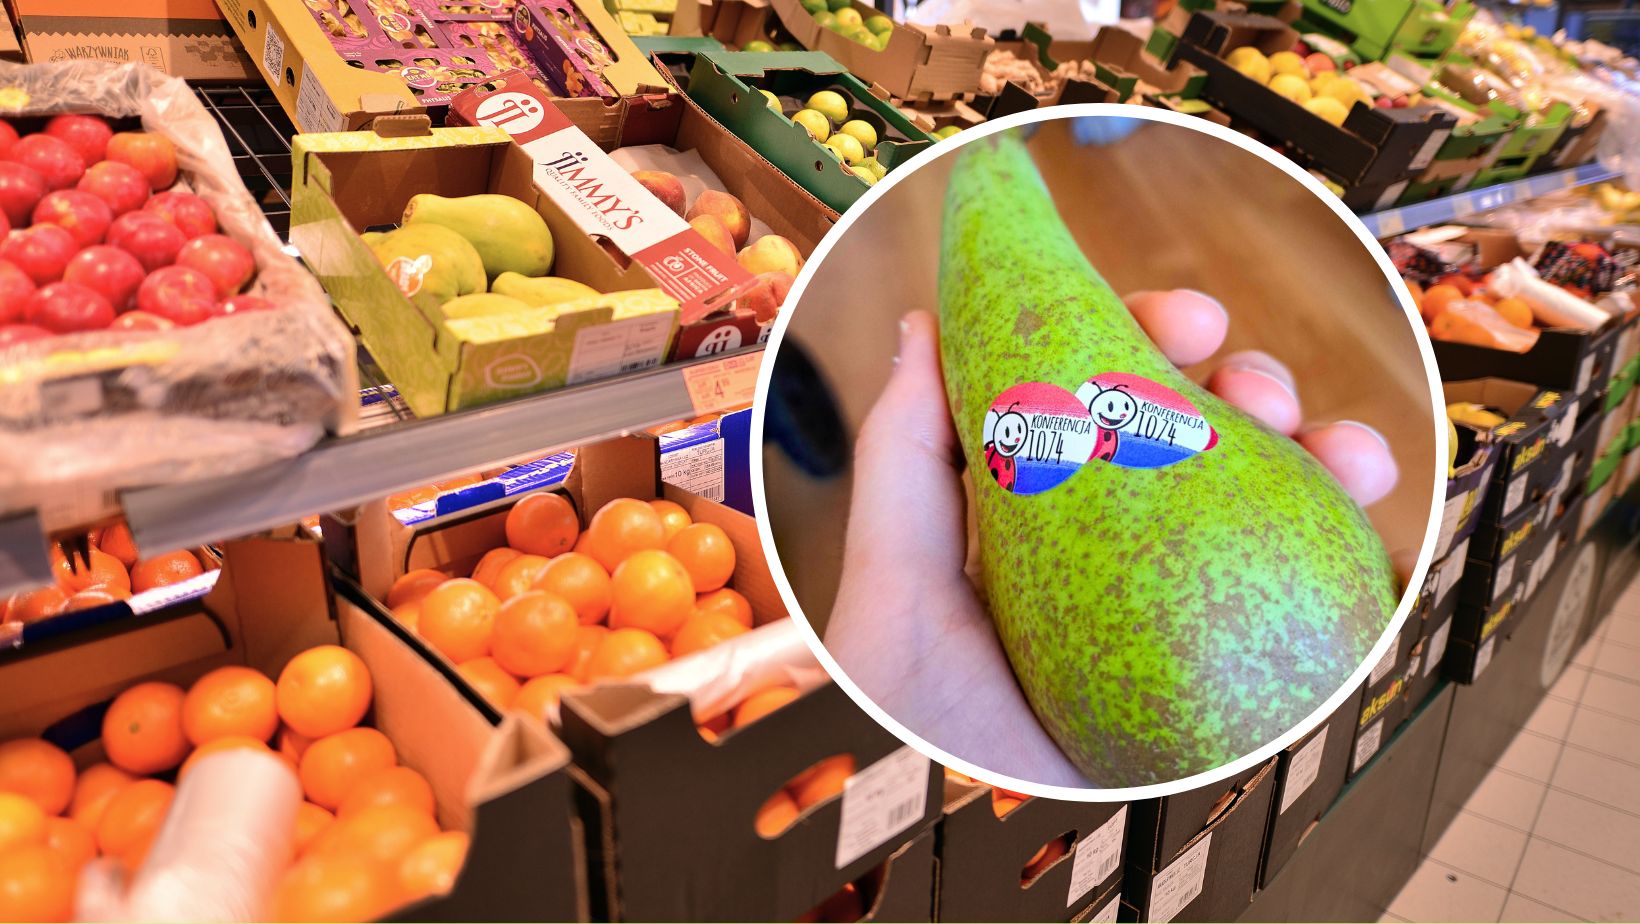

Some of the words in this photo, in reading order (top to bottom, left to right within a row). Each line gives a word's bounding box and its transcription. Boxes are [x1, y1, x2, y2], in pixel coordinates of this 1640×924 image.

[65, 46, 129, 61] WARZYWNIAK
[545, 167, 572, 192] QUALITY
[570, 188, 593, 211] FAMILY
[591, 209, 614, 231] FOODS
[684, 247, 709, 267] STONE
[706, 265, 729, 282] FRUIT
[1031, 414, 1091, 435] KONFERENCJA
[1134, 411, 1177, 447] 1074
[1141, 401, 1204, 431] KONFERENCJA
[1026, 429, 1064, 464] 1074
[683, 469, 691, 477] kg
[1360, 677, 1404, 726] aksun
